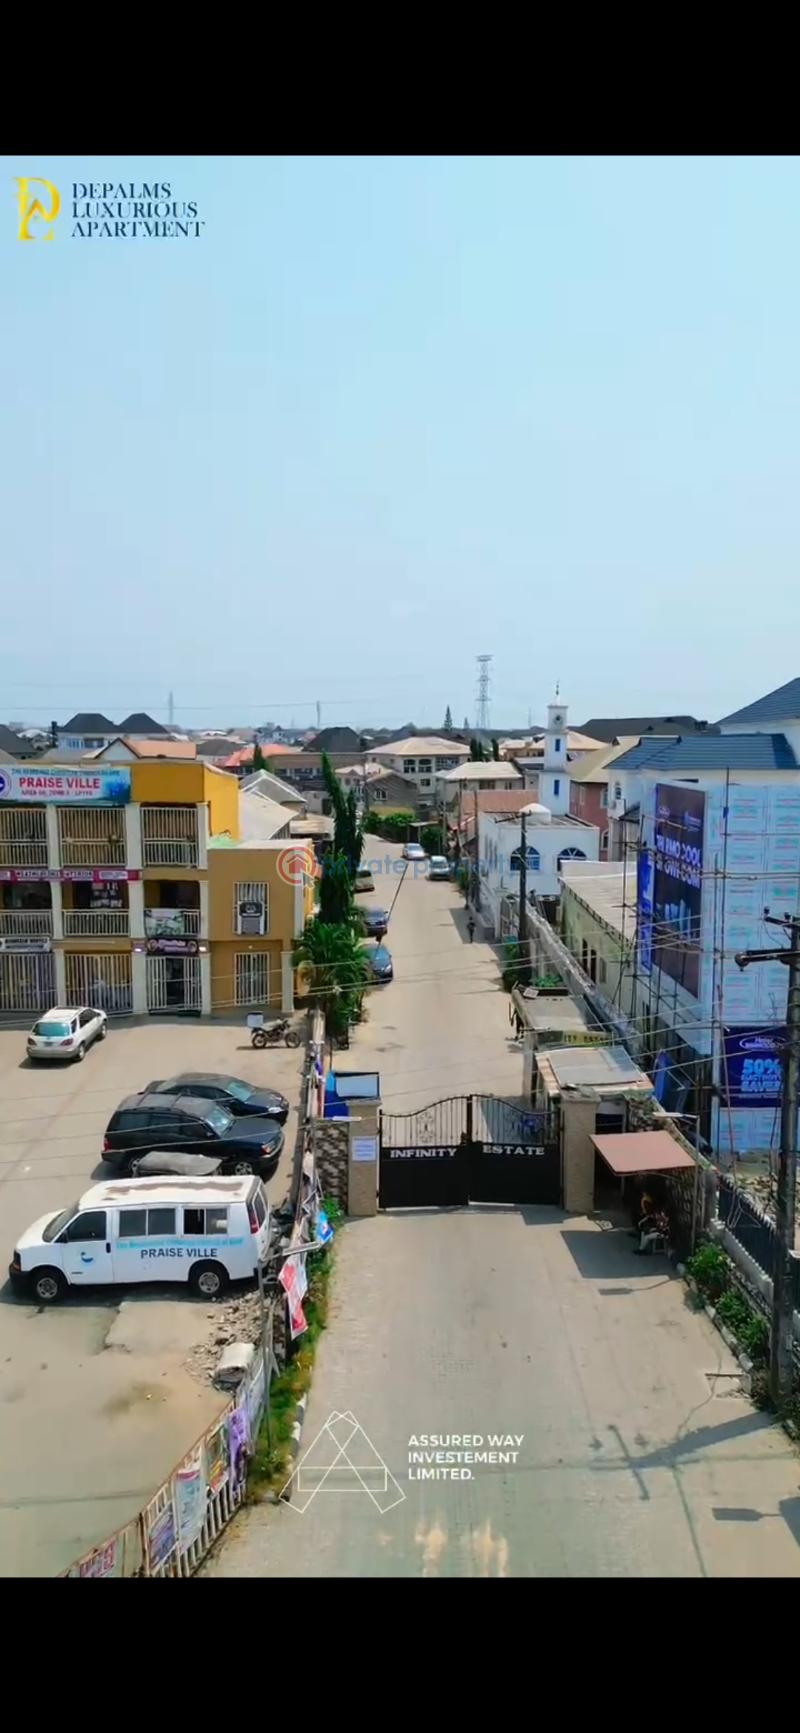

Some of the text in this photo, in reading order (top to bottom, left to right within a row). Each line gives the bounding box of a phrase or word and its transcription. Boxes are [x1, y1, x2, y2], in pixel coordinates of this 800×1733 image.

[19, 777, 101, 788] PRAISE VILLE
[742, 1058, 782, 1074] 50%
[390, 1144, 545, 1158] INFINITY ESTATE
[140, 1247, 218, 1259] PRAISE VILLE
